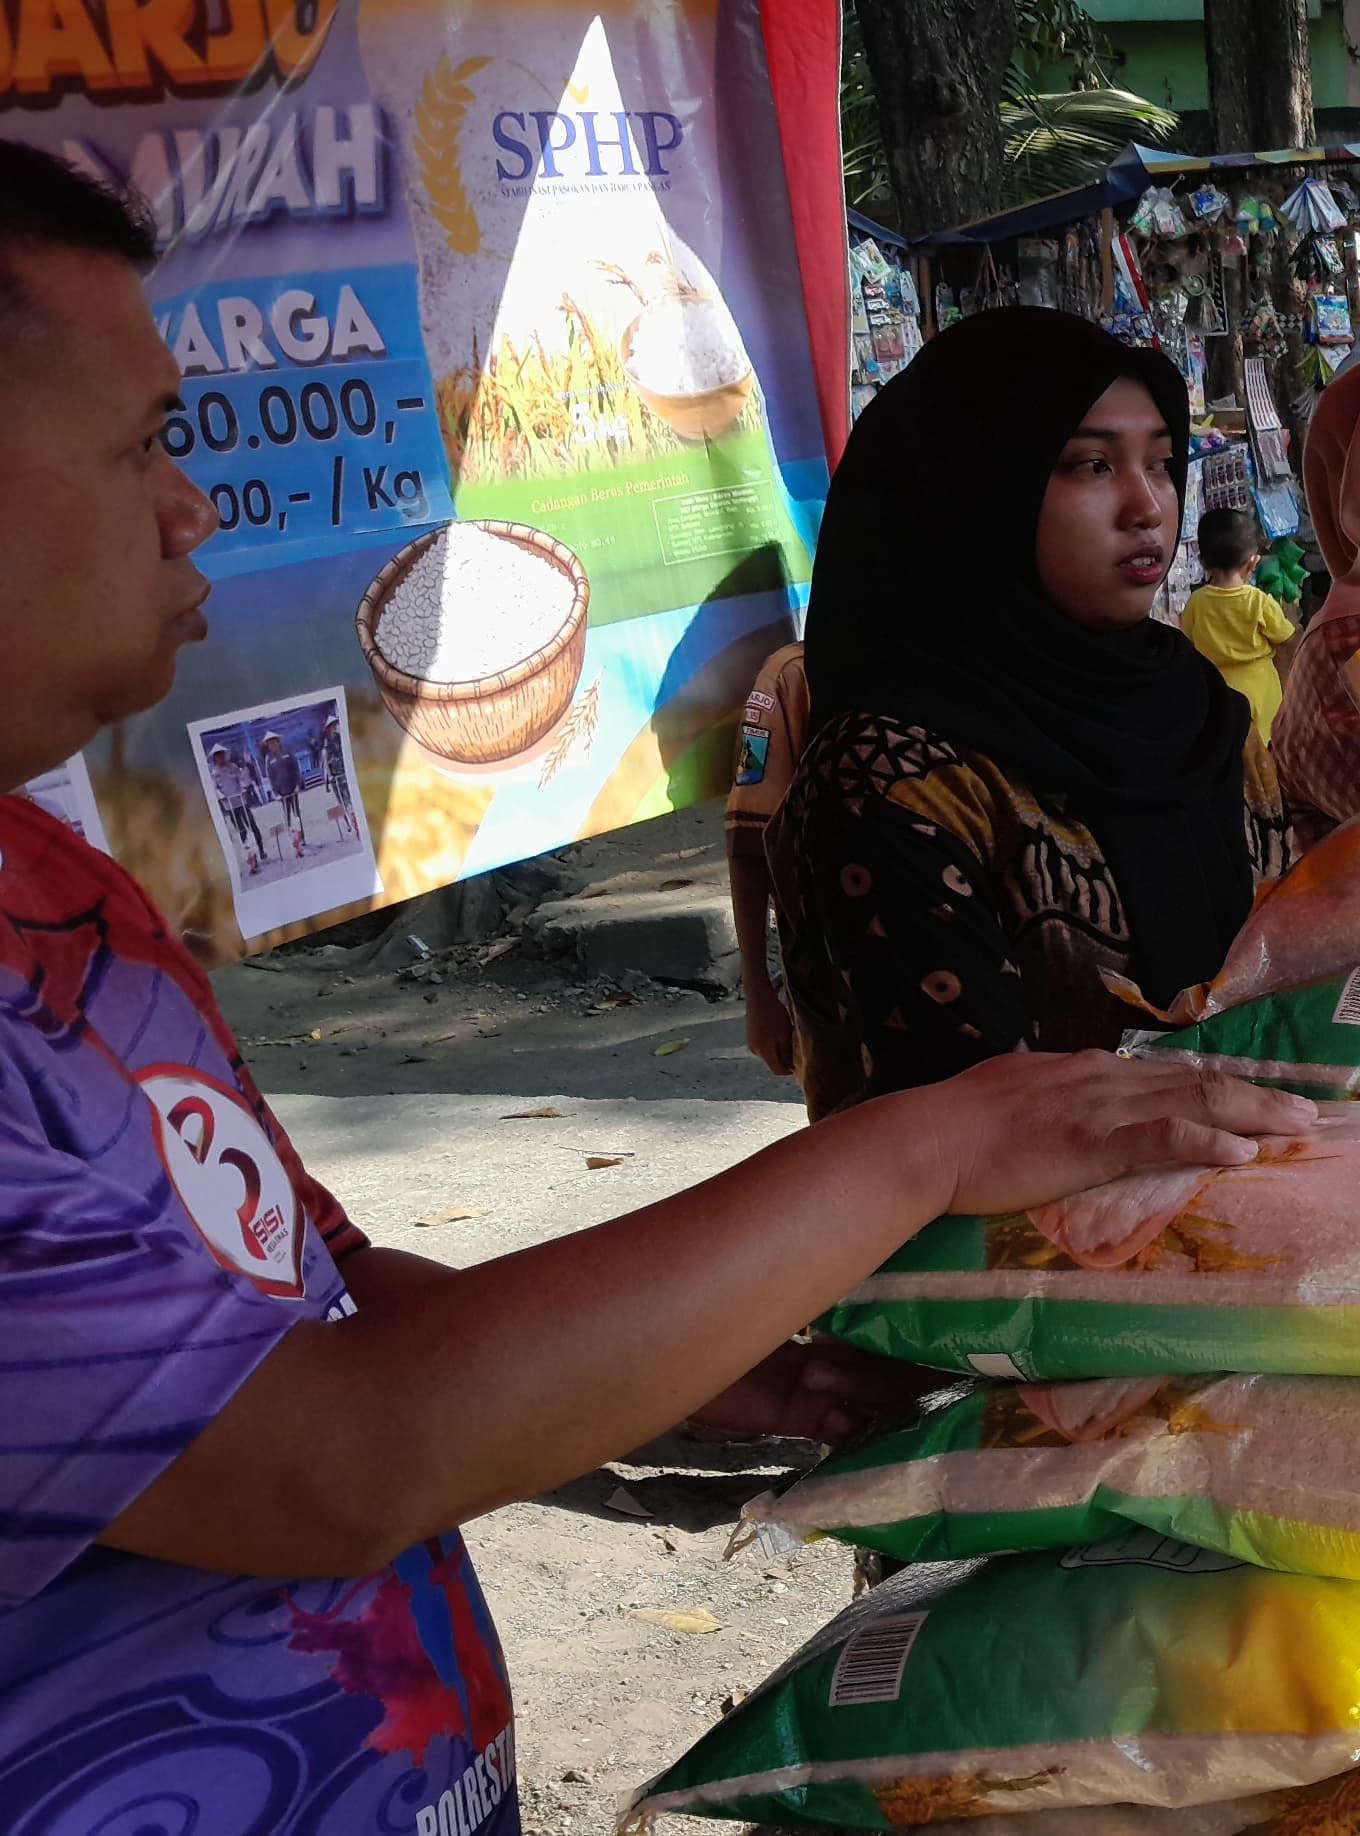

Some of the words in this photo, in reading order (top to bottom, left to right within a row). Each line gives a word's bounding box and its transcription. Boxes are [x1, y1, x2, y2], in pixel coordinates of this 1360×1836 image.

[0, 0, 340, 95] ARJO
[492, 111, 684, 180] SPHP
[152, 284, 386, 378] ARGA
[362, 465, 431, 521] Kg
[531, 488, 588, 515] Cadangan
[625, 472, 689, 496] Pemerintah
